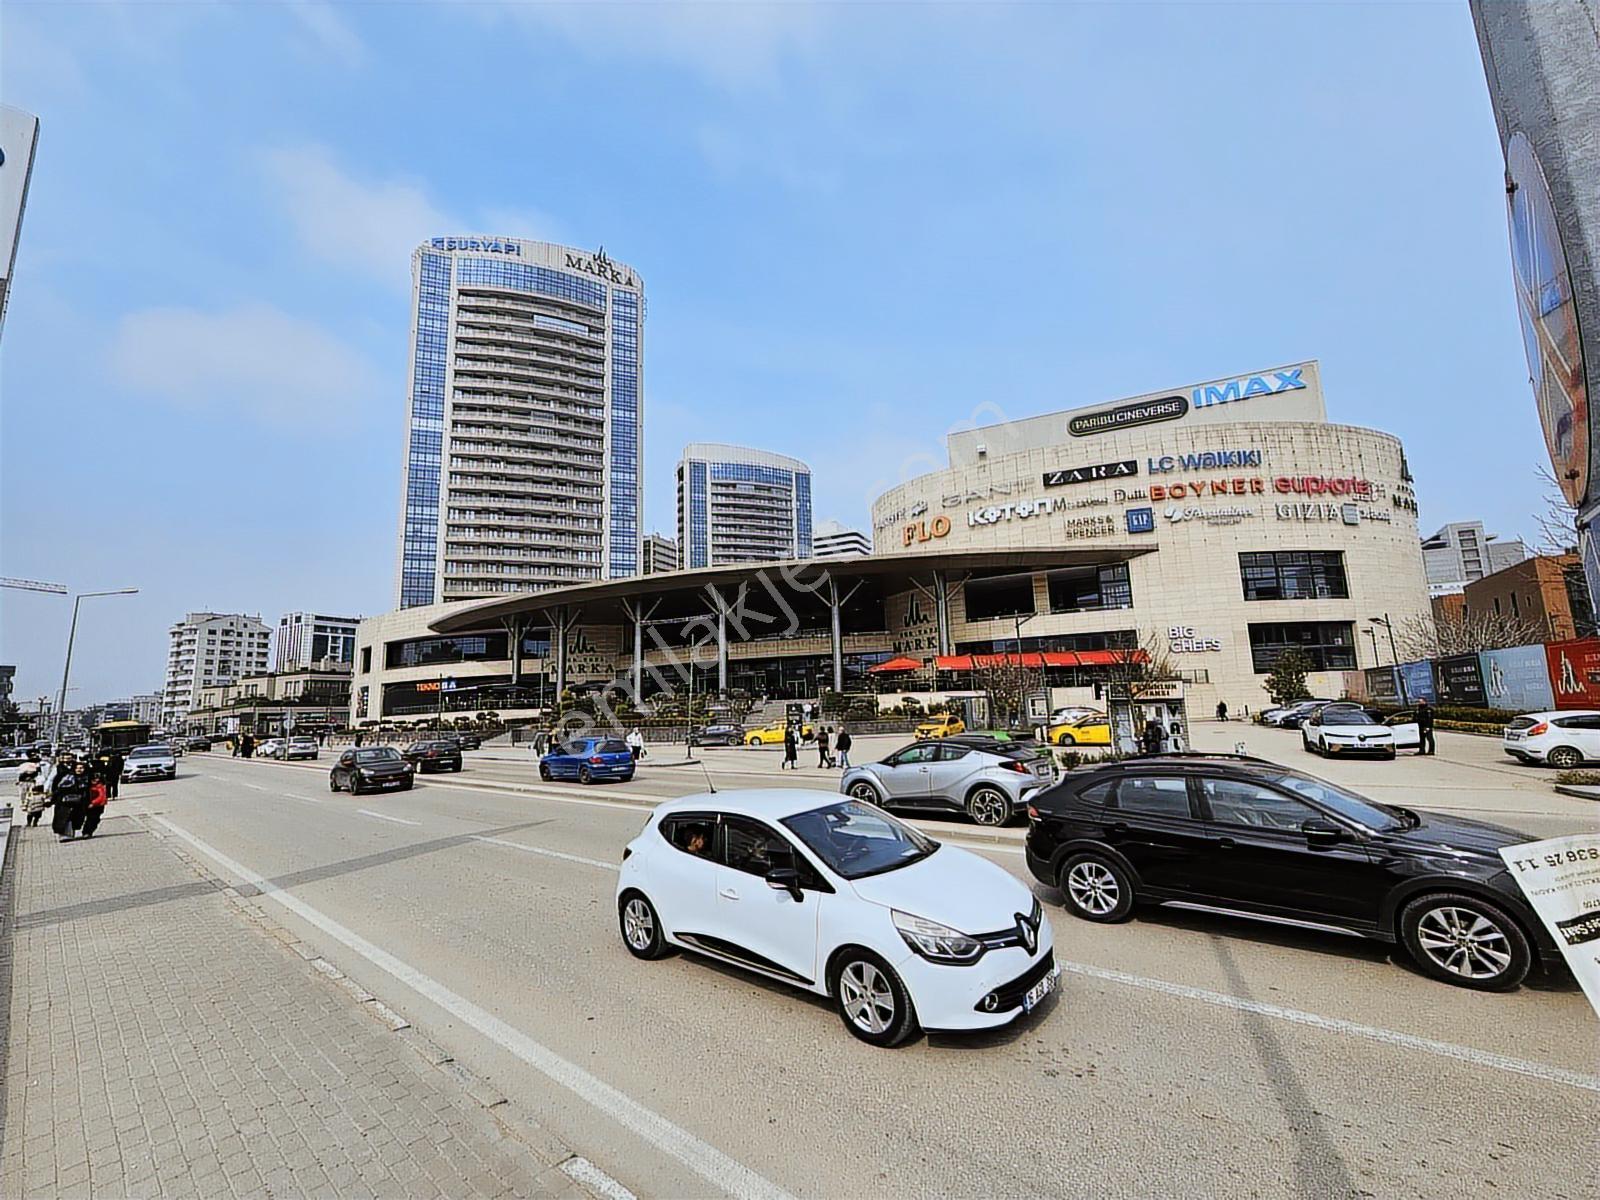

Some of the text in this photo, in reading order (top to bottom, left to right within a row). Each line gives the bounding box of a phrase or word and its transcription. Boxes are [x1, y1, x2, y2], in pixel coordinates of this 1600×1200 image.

[565, 253, 634, 287] MARKA
[1192, 369, 1306, 409] IMAX
[1116, 401, 1180, 422] CINEVERSE
[1048, 463, 1132, 485] ZARA
[1148, 456, 1175, 475] LC
[1150, 477, 1265, 501] BOYNER
[967, 497, 1053, 527] KOTON
[1131, 513, 1149, 526] GAP
[1275, 502, 1342, 521] GIZIA
[902, 515, 952, 547] FLO
[1067, 515, 1104, 528] MARKS
[1066, 524, 1116, 539] SPENCER
[1168, 625, 1196, 640] BIG
[892, 636, 938, 653] MARK
[1170, 639, 1222, 653] CHEFS
